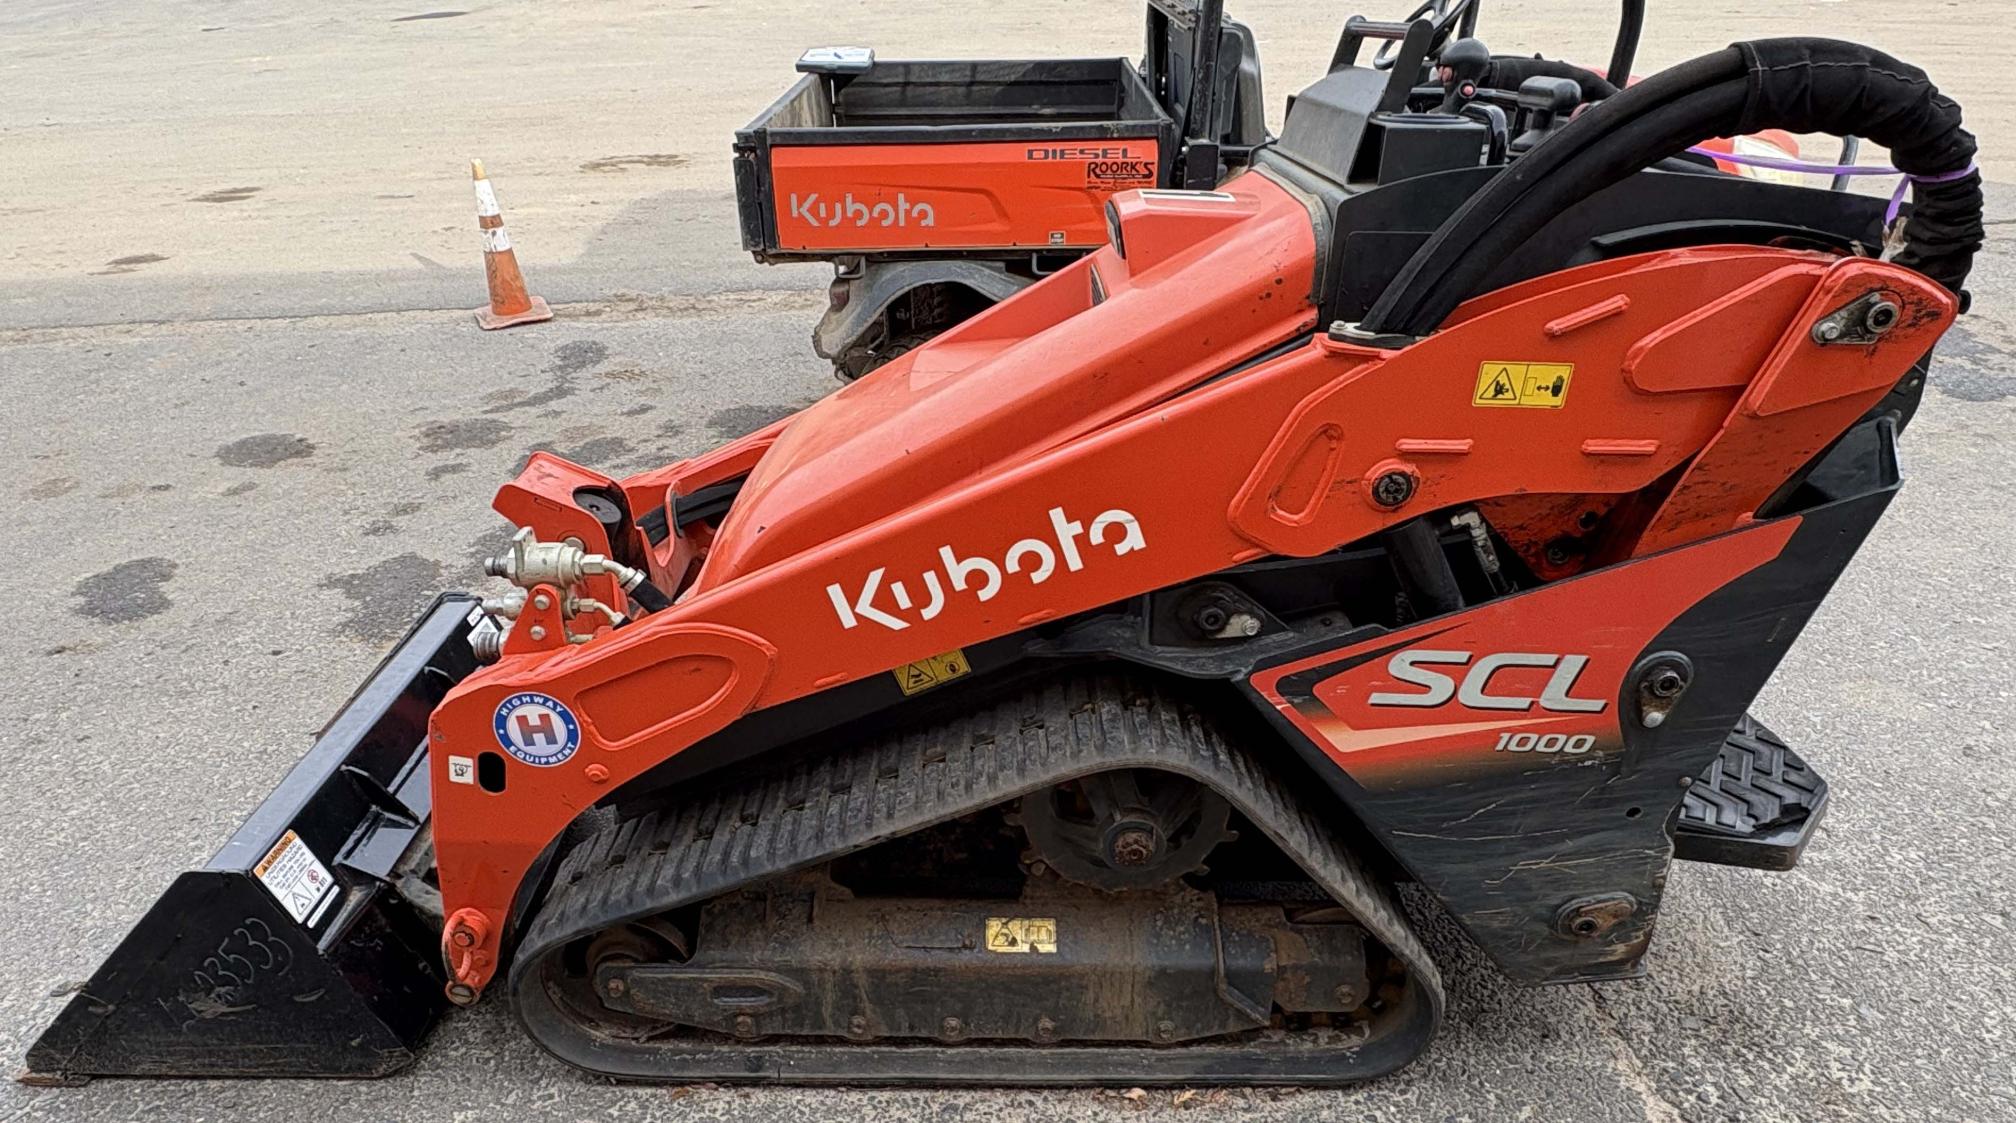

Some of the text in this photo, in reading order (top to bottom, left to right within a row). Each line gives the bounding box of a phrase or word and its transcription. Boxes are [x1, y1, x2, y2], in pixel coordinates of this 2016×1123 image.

[1027, 148, 1141, 160] DIESEL
[1087, 161, 1156, 180] ROORK'S
[790, 192, 935, 227] Kubota
[826, 506, 1147, 631] Kubota
[1367, 650, 1609, 713] SCL
[500, 695, 564, 716] HIGHWAY
[515, 713, 559, 747] H
[1494, 732, 1596, 754] 1000
[508, 741, 575, 764] EQUIPMENT
[265, 836, 292, 866] WARNING
